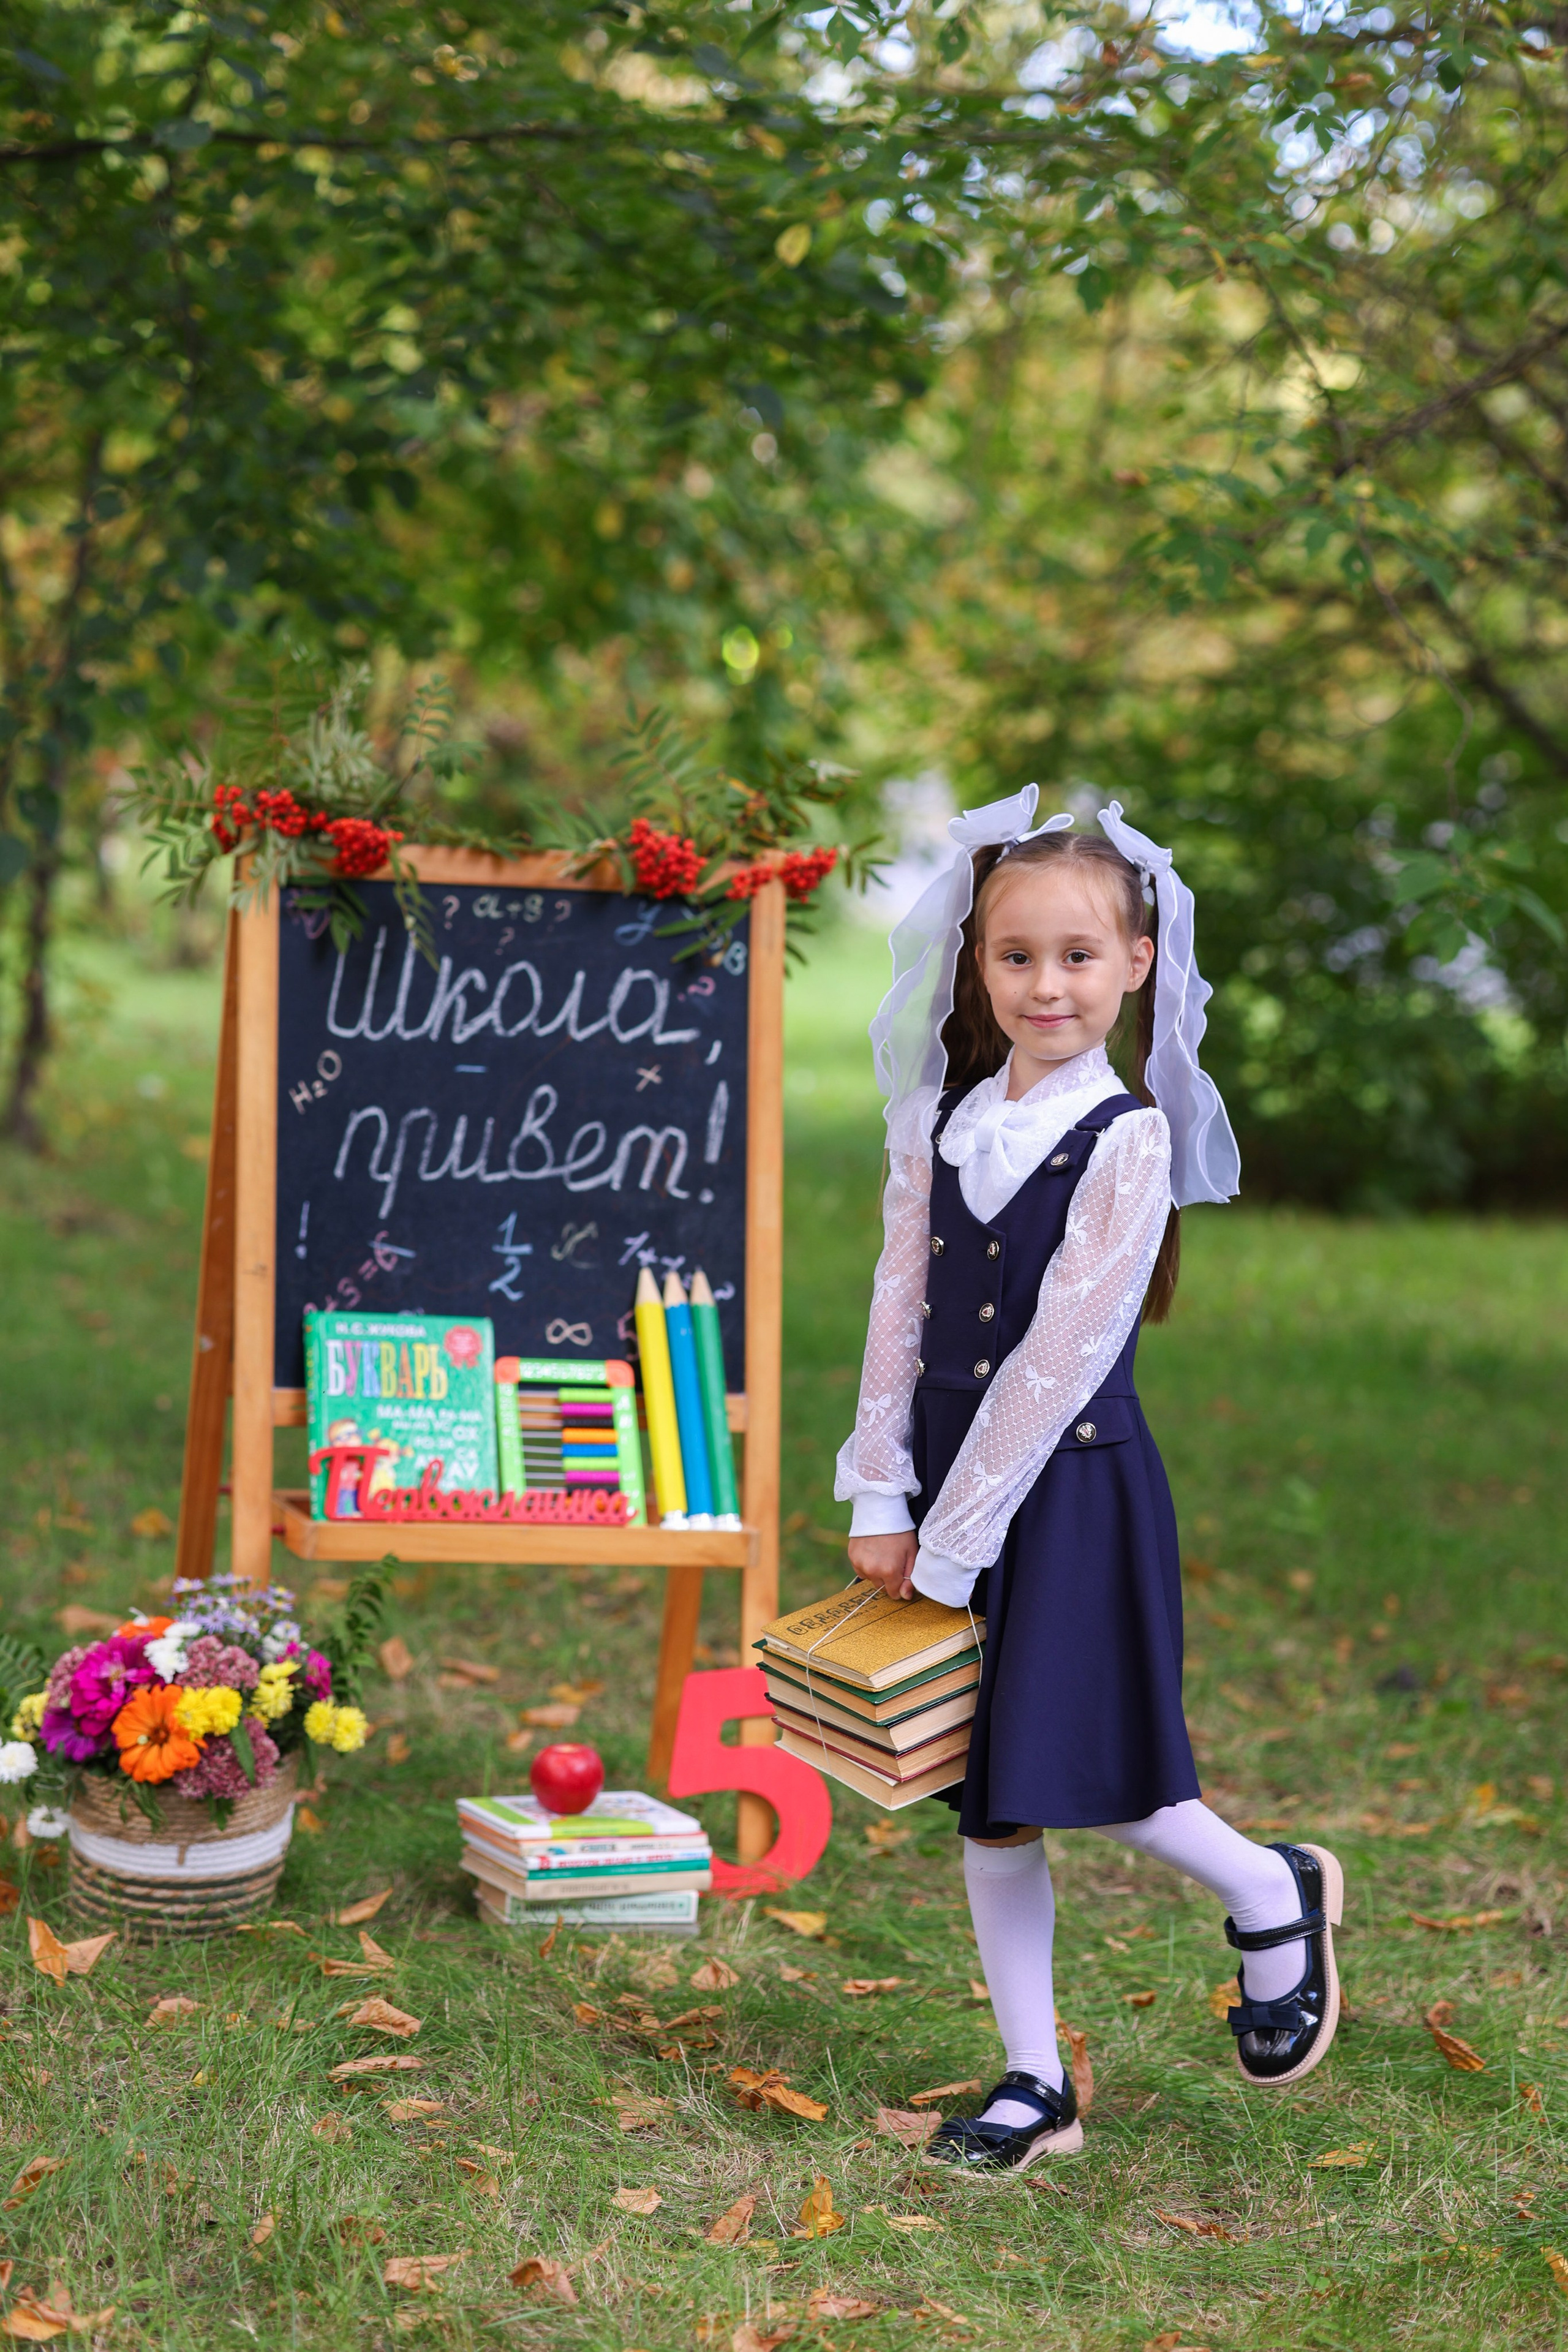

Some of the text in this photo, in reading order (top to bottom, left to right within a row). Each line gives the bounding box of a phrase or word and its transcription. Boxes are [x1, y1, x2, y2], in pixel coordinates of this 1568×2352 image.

[334, 1080, 729, 1219] привет!
[325, 1338, 448, 1401] БУКВАРЬ
[668, 1667, 832, 1899] 5
